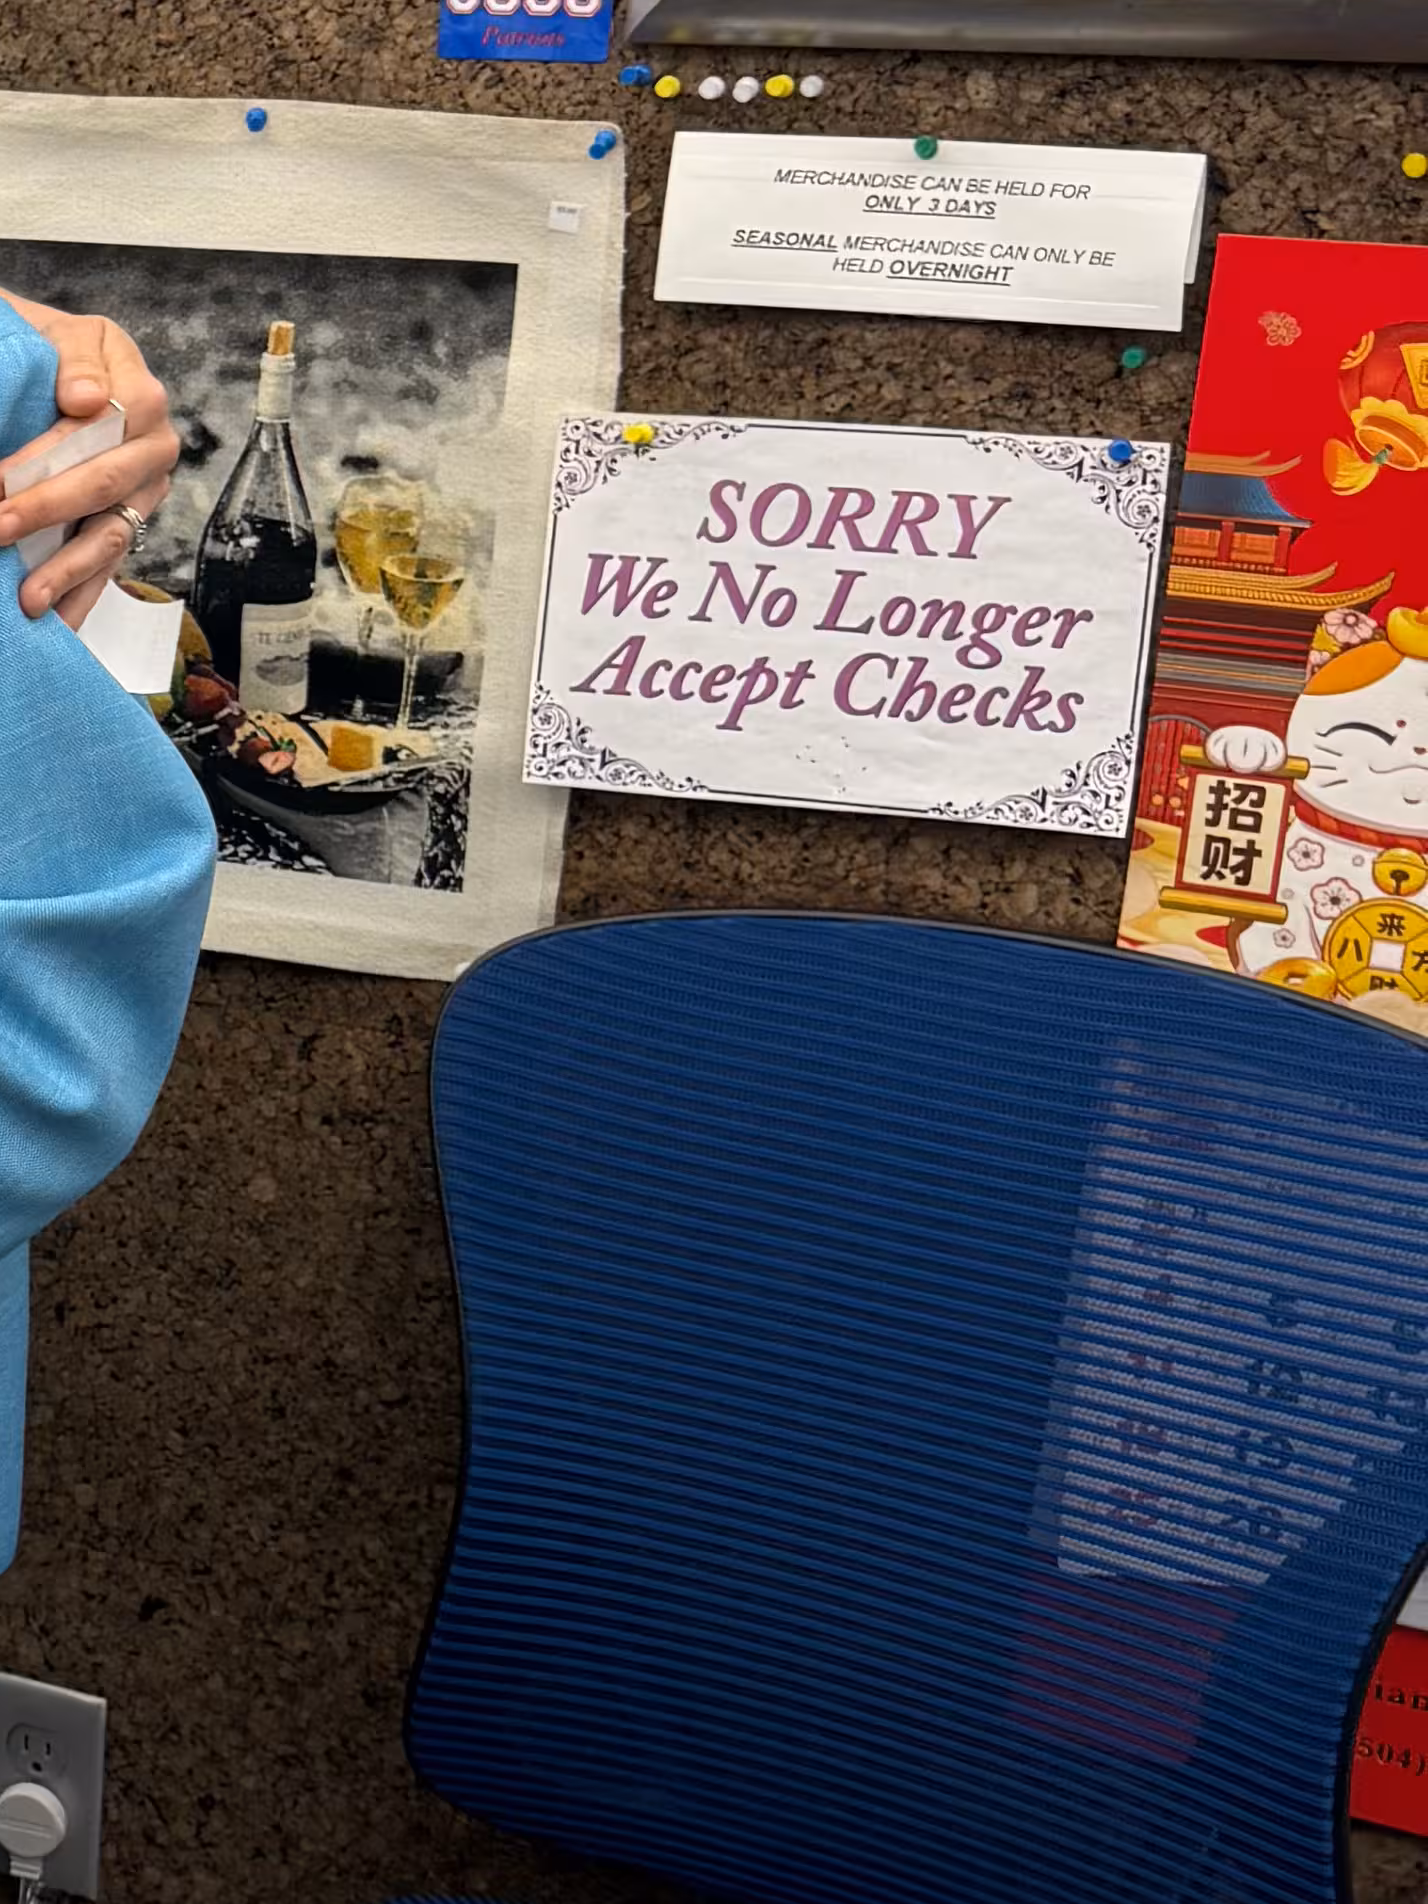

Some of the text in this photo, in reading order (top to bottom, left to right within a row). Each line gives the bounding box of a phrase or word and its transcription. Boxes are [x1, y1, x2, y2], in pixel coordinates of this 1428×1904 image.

[774, 168, 1091, 200] MERCHANDISE CAN BE HELD FOR
[864, 193, 997, 217] ONLY 3 DAYS
[732, 228, 1116, 268] SEASONAL MERCHANDISE CAN ONLY BE
[833, 255, 1014, 285] HELD OVERNIGHT
[695, 478, 1013, 560] SORRY
[578, 553, 1093, 670] We No Longer
[569, 634, 1085, 734] Accept Checks
[1200, 779, 1268, 887] 招财
